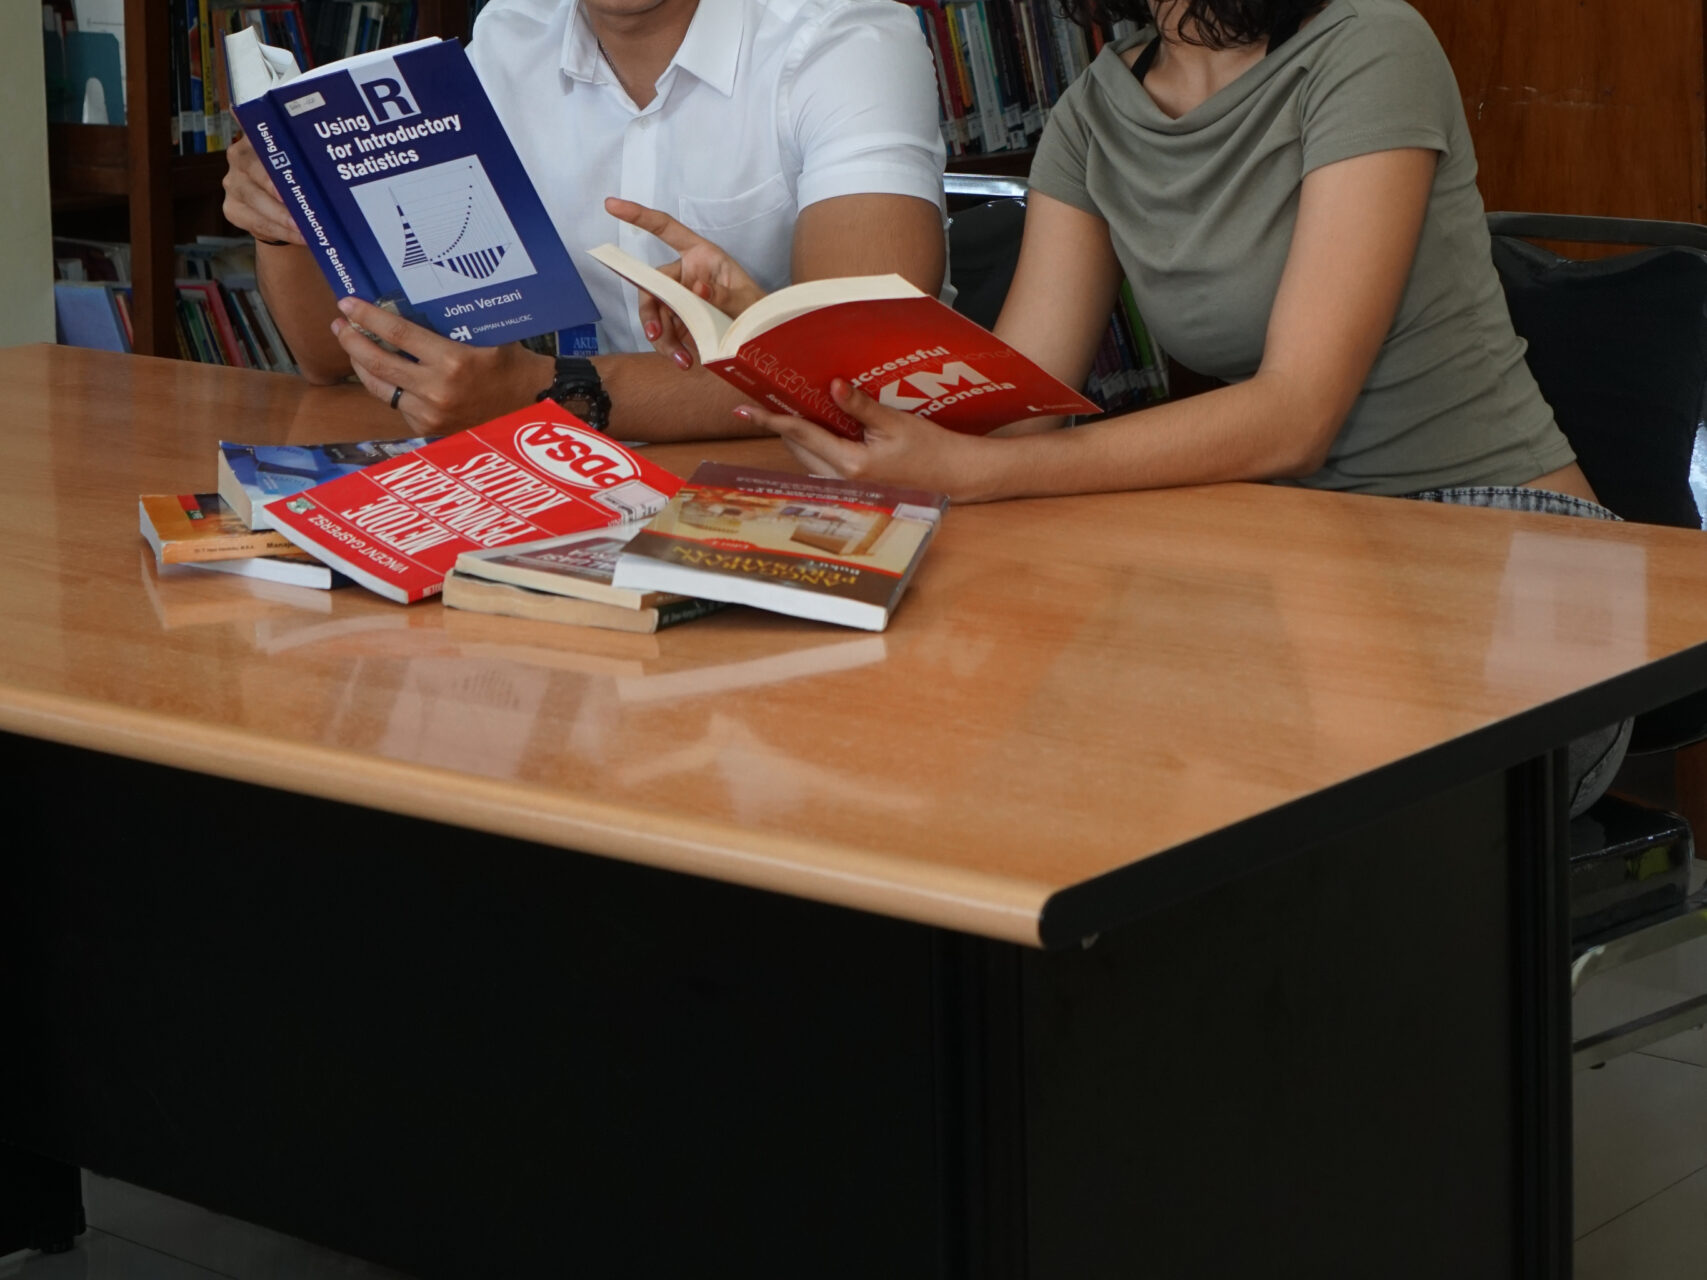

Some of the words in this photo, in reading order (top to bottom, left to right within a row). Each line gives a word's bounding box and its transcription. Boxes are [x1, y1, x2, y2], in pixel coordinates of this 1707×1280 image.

[314, 114, 370, 139] Using
[360, 77, 415, 122] R
[326, 143, 352, 161] for
[354, 114, 461, 154] Introductory
[337, 149, 420, 181] Statistics
[257, 122, 278, 153] Using
[270, 152, 290, 170] R
[282, 169, 296, 185] for
[291, 186, 330, 247] Introductory
[326, 247, 356, 295] Statistics
[444, 303, 475, 318] John
[474, 289, 522, 309] Verzani
[472, 323, 501, 334] CHAPMAN
[851, 345, 951, 389] uccessful
[879, 360, 992, 412] KM
[915, 381, 1017, 418] ndonesia
[524, 423, 622, 487] PDSA
[374, 460, 536, 548] PENINGKATAN
[448, 453, 572, 519] KUALITAS
[266, 541, 292, 550] Manaj
[307, 514, 367, 549] GASPERSZ
[341, 498, 458, 556] METODE
[358, 546, 409, 575] VINCENT
